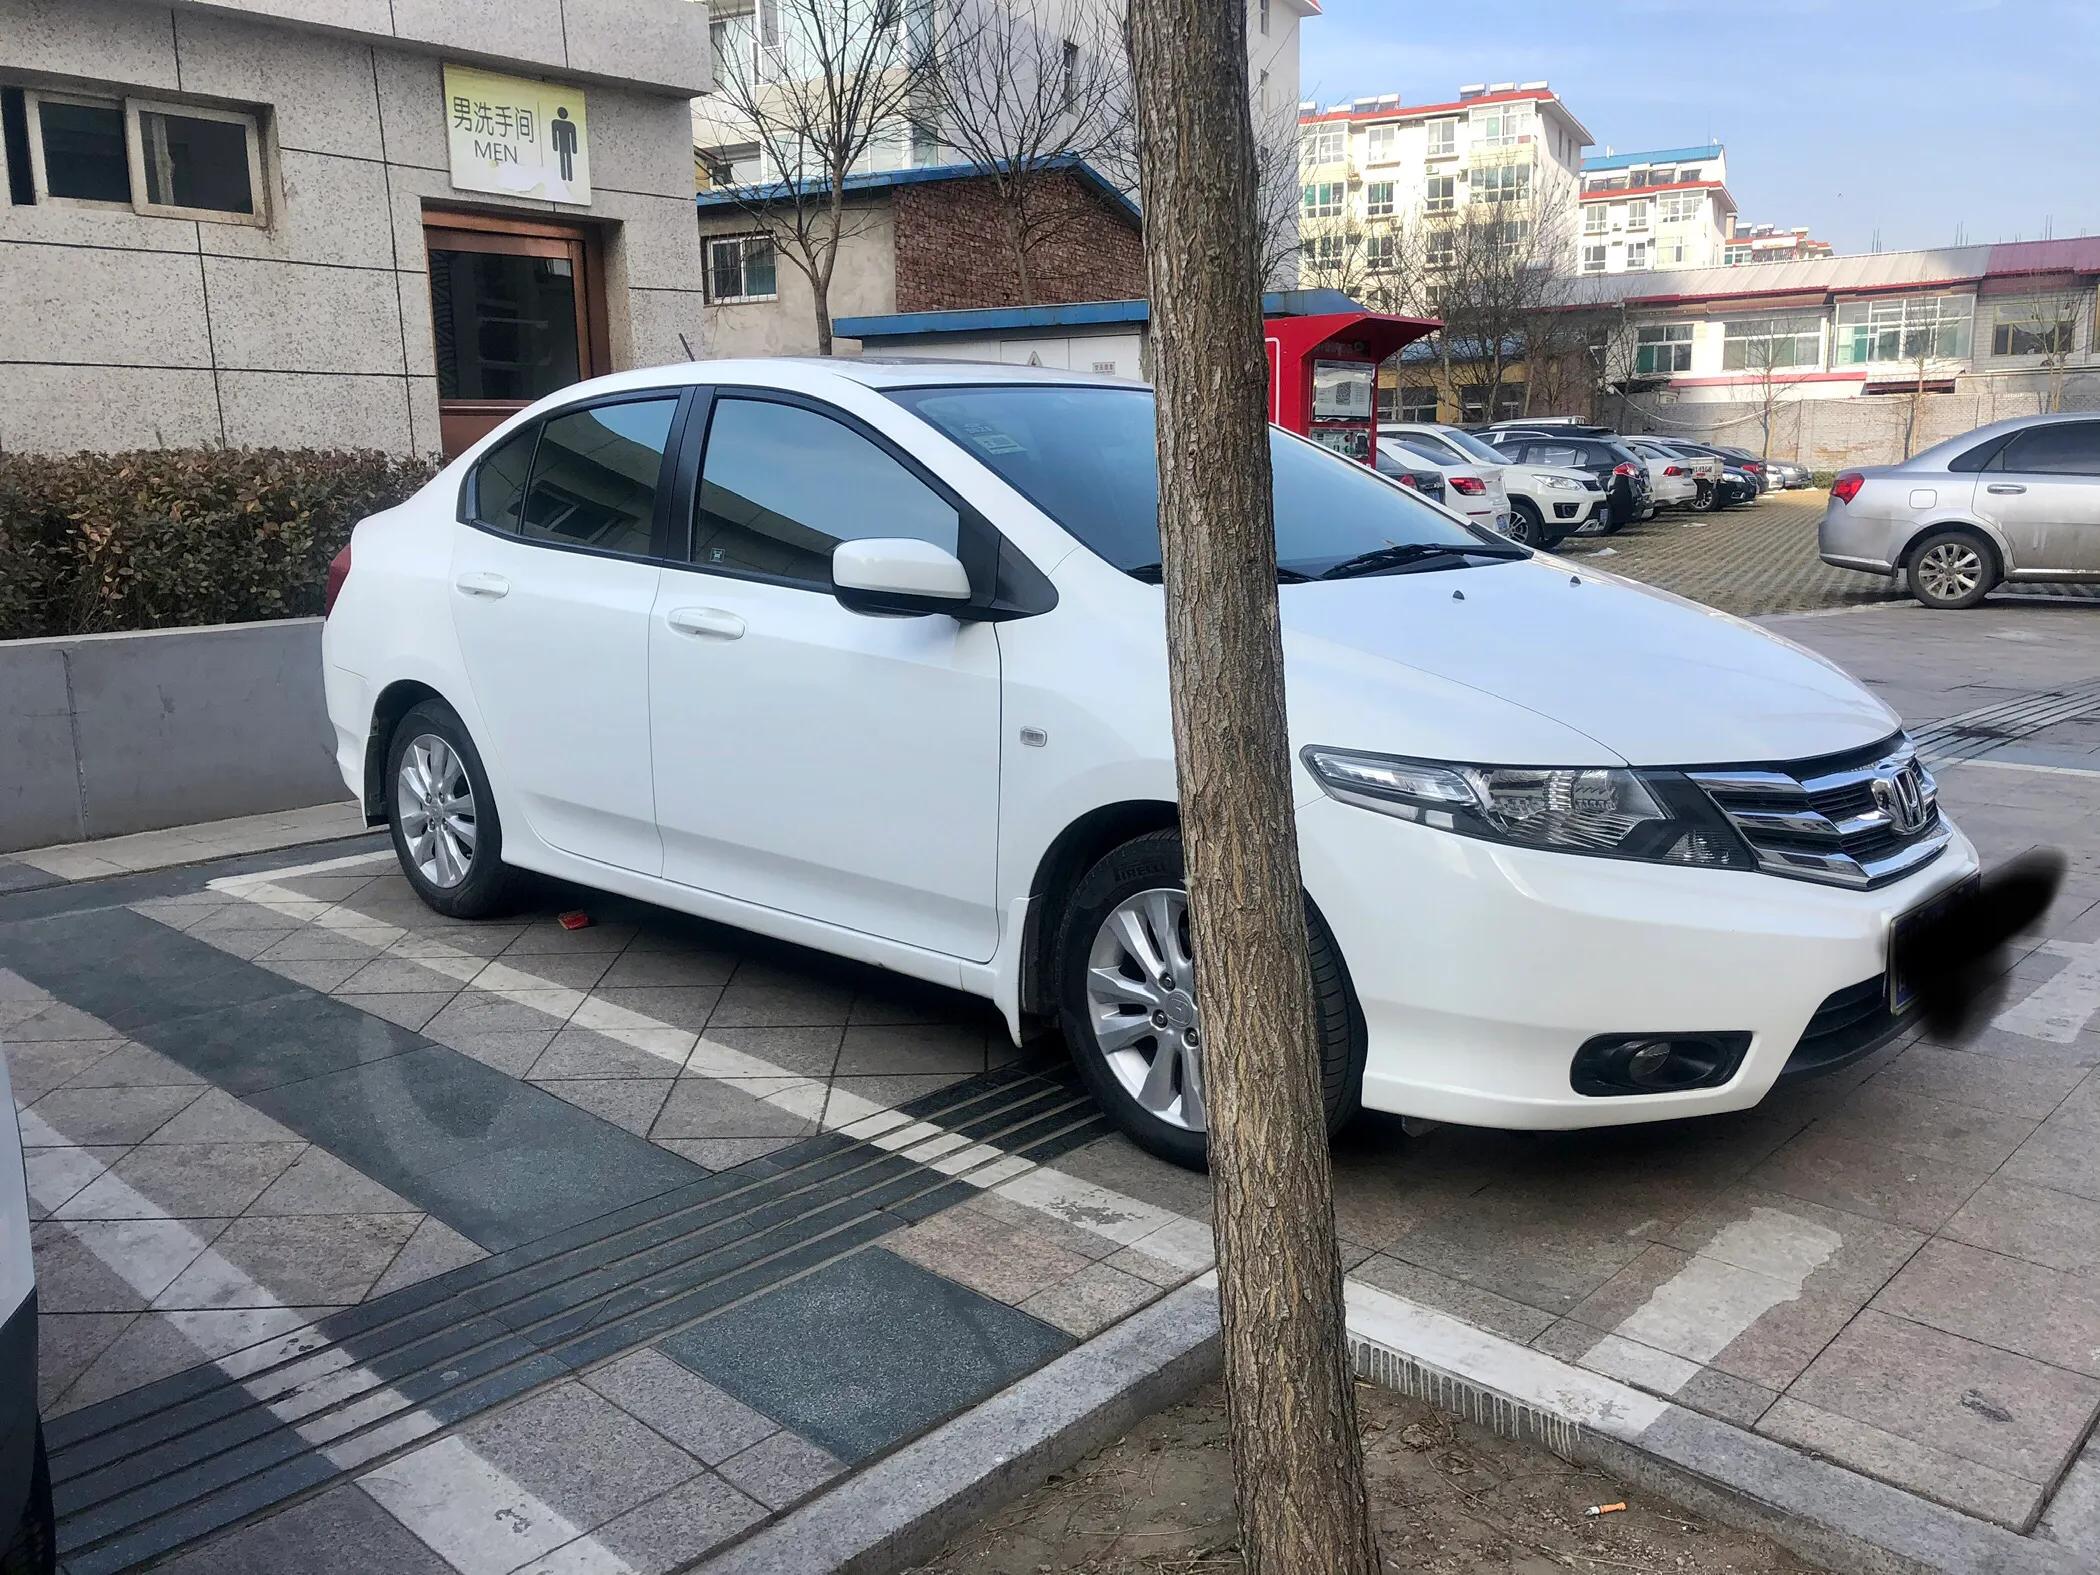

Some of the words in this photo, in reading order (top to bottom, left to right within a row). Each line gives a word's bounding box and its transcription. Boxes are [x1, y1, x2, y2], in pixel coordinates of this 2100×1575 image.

[453, 96, 535, 144] 男洗手间
[474, 139, 518, 164] MEN
